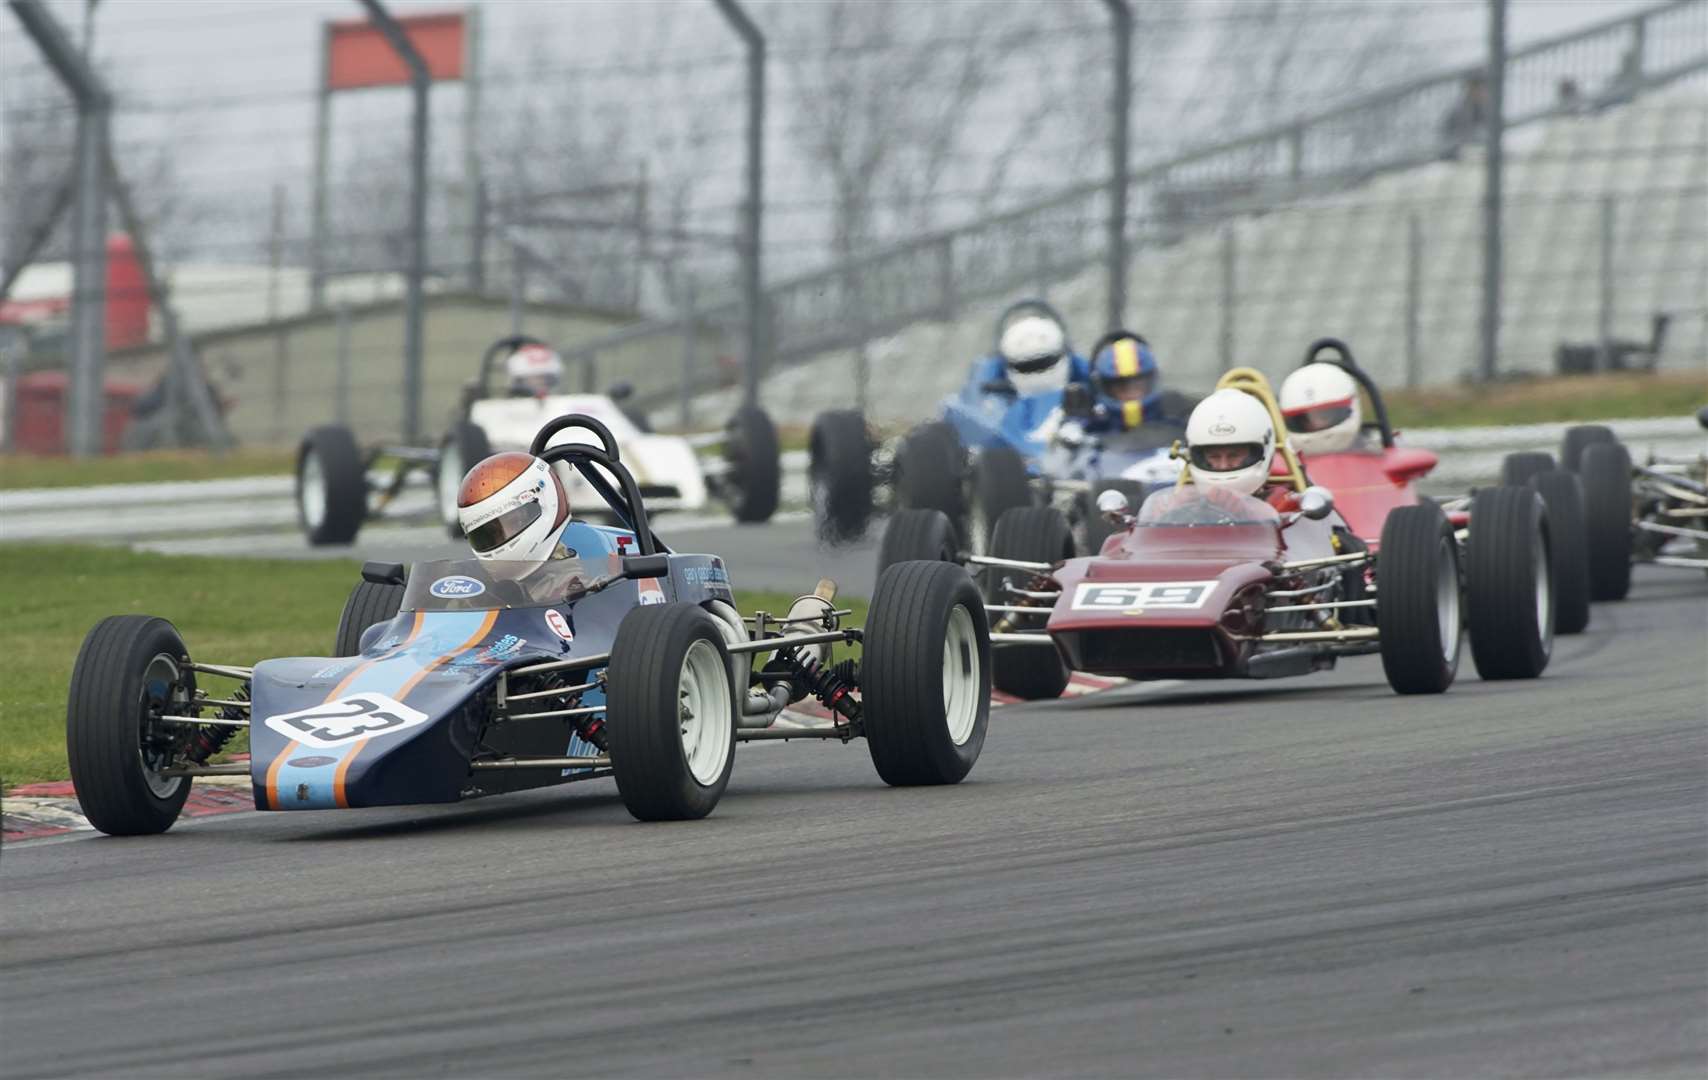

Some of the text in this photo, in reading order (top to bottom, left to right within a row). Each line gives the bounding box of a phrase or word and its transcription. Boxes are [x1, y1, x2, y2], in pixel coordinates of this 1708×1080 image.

[440, 580, 473, 594] Ford
[1081, 585, 1209, 607] 69
[547, 613, 571, 638] E
[283, 699, 406, 742] 23
